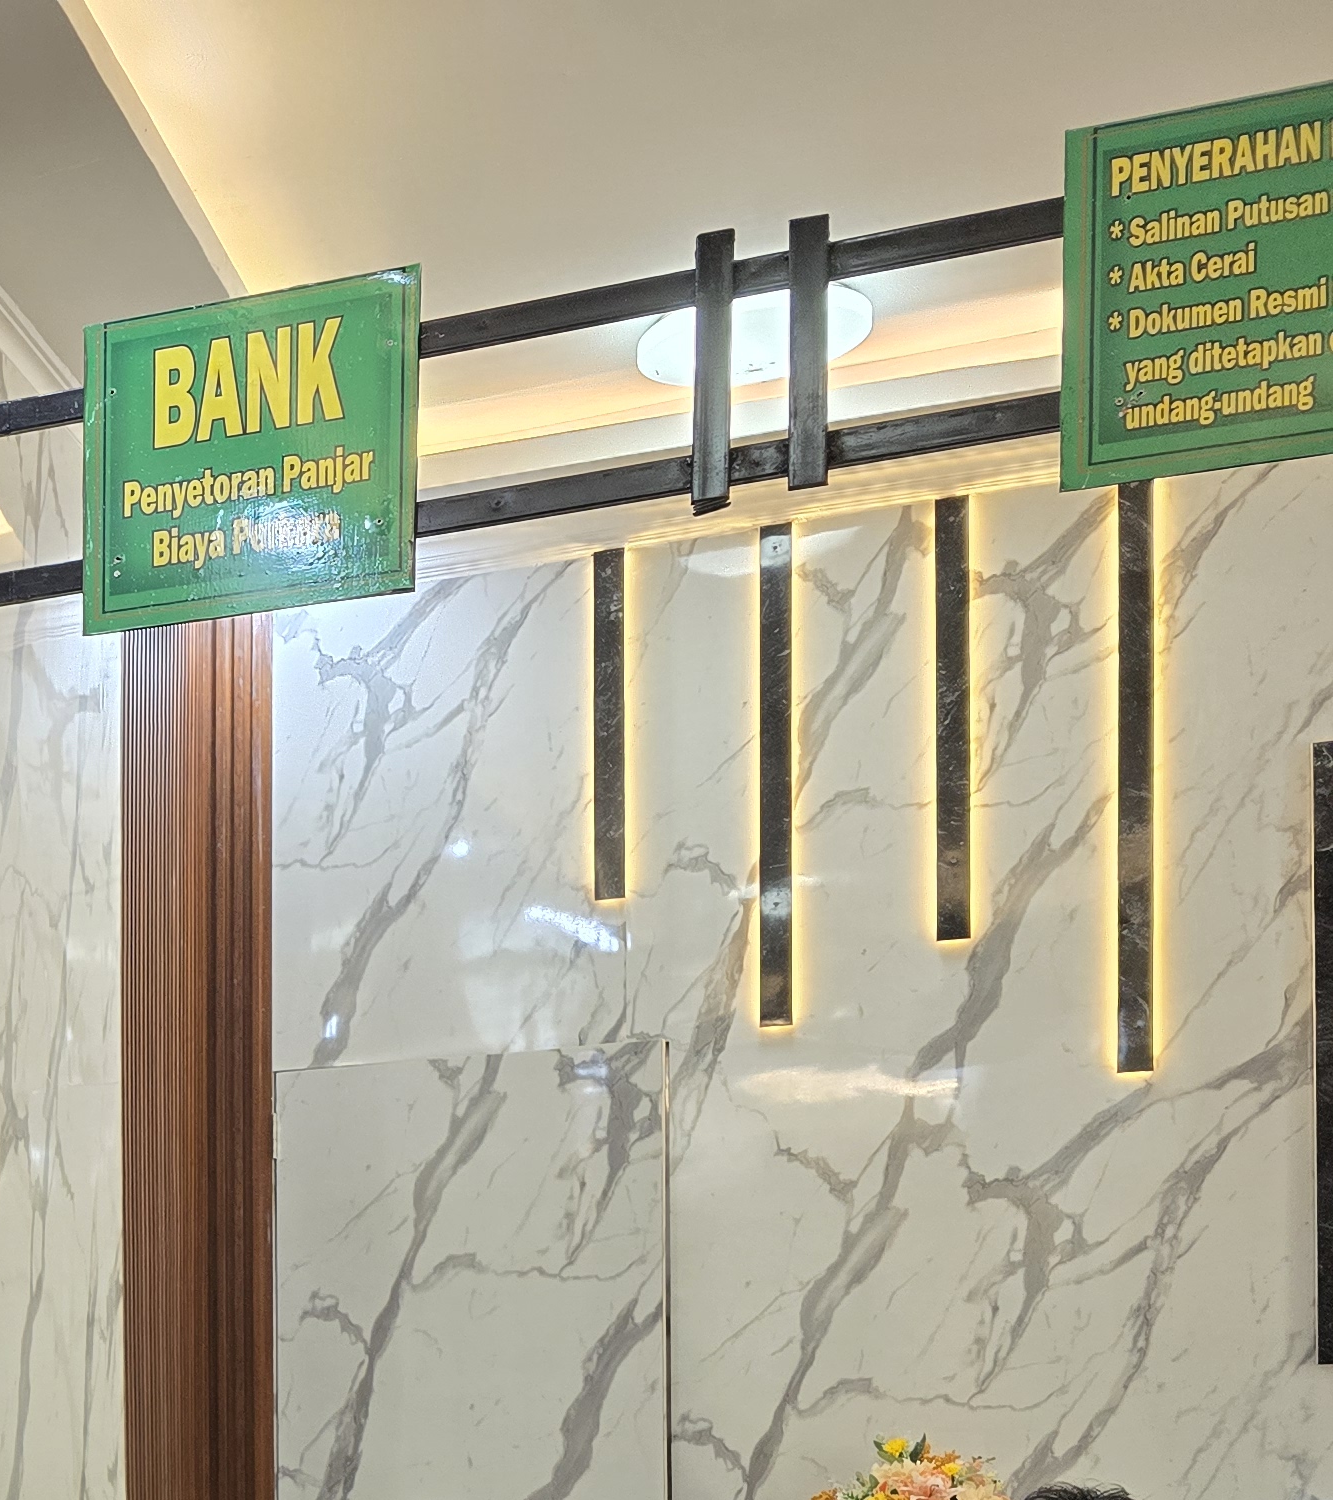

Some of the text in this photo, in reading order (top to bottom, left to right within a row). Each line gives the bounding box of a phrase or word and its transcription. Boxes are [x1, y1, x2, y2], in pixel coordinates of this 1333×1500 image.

[1109, 120, 1322, 198] PENYERAHAN
[1128, 189, 1329, 247] Salinan Putusan
[1127, 242, 1257, 294] Akta Cerai
[1127, 277, 1328, 339] Dokumen Resmi
[152, 315, 345, 451] BANK
[1124, 348, 1185, 391] yang
[1188, 329, 1322, 376] ditetapkan
[1124, 374, 1316, 431] undang-undang
[122, 446, 376, 518] Penyetoran Panjar
[152, 526, 225, 570] Biaya
